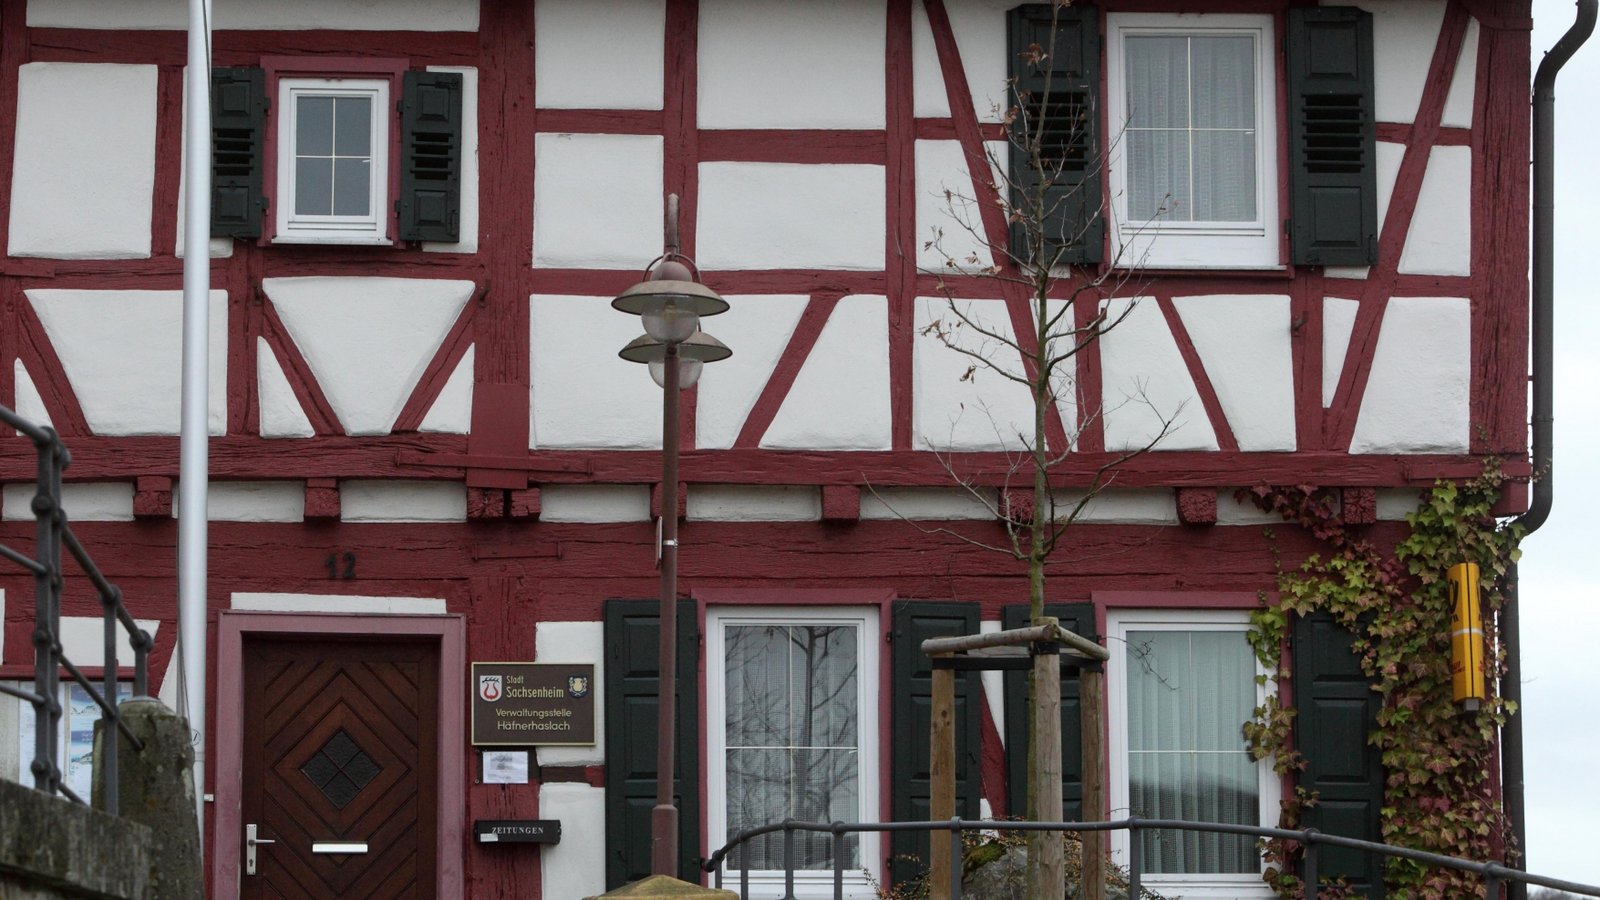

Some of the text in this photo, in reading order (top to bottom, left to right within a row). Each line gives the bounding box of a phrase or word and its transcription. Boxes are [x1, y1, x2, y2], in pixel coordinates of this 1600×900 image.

[506, 675, 524, 684] Stadt
[506, 686, 564, 698] Sachsenheim
[495, 708, 572, 719] Verwaltungsstelle
[497, 721, 571, 731] Häfnerhaslach
